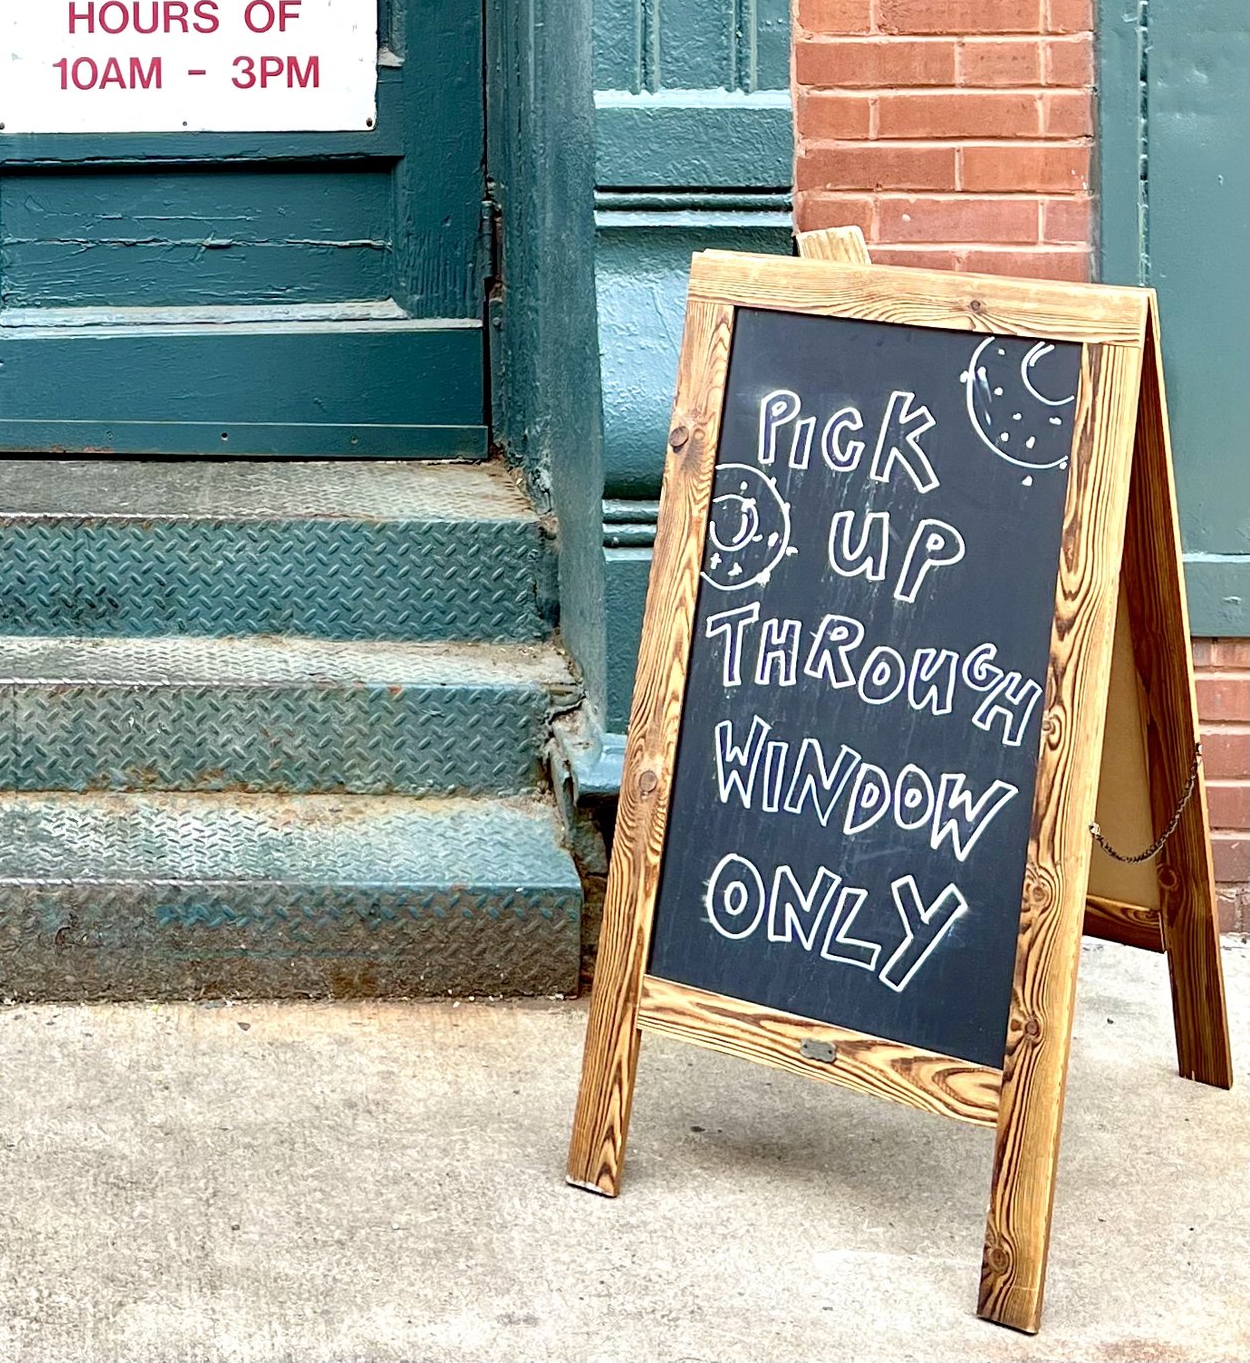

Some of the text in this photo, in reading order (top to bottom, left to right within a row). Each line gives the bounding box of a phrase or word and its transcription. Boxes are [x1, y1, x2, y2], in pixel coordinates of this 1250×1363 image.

[68, 0, 302, 34] HOURS OF
[52, 56, 162, 91] 10AM
[231, 55, 320, 90] 3PM
[758, 390, 941, 493] PICK
[828, 510, 966, 604] UP
[706, 602, 1043, 746] THROUGH
[714, 715, 1019, 862] WINDOW
[706, 852, 968, 993] ONLY
